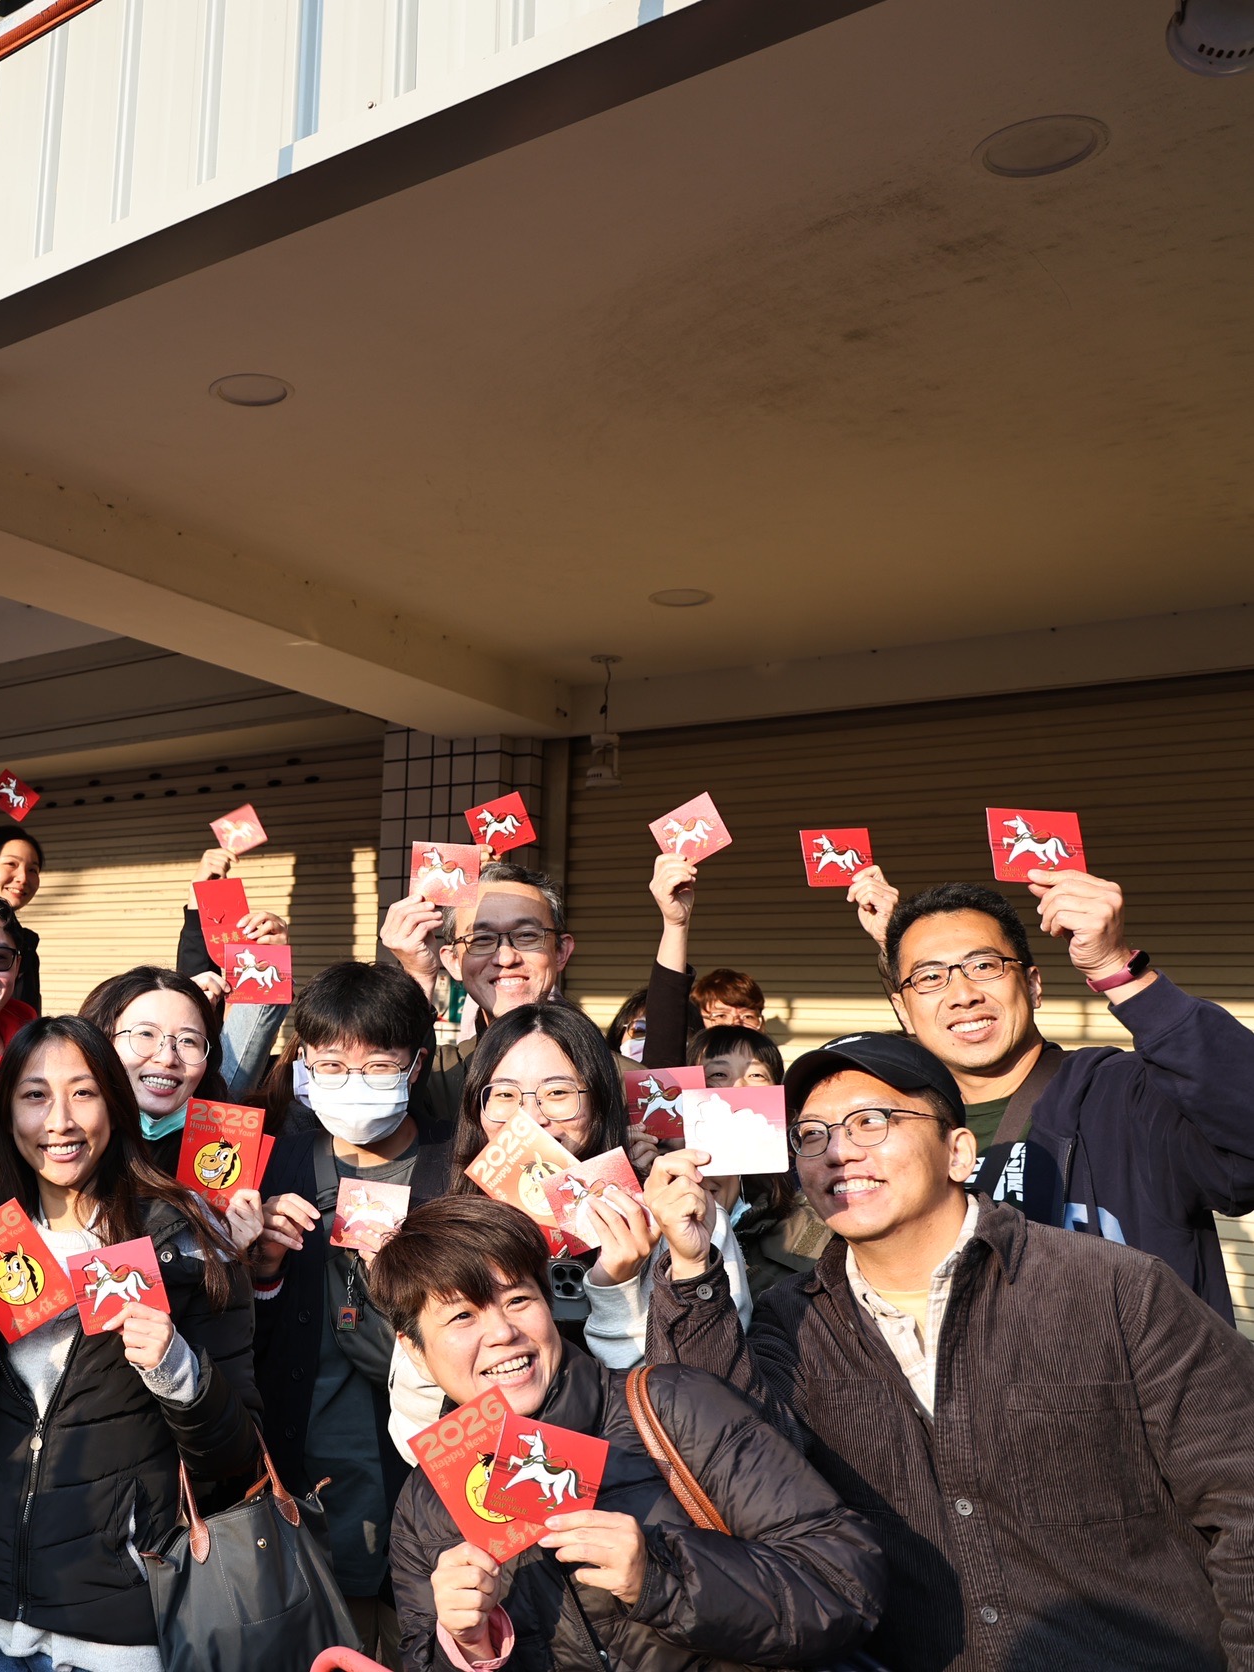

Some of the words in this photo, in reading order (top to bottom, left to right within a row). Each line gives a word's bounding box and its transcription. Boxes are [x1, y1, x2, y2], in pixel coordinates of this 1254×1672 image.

[189, 1121, 217, 1133] Happy
[218, 1126, 236, 1135] New
[238, 1128, 257, 1138] Year
[190, 1103, 259, 1129] 2026
[472, 1115, 532, 1184] 2026
[486, 1165, 512, 1191] Happy
[507, 1147, 525, 1166] New
[7, 1223, 27, 1238] Year
[416, 1393, 505, 1463] 2026
[429, 1447, 466, 1473] Happy
[464, 1433, 488, 1451] New
